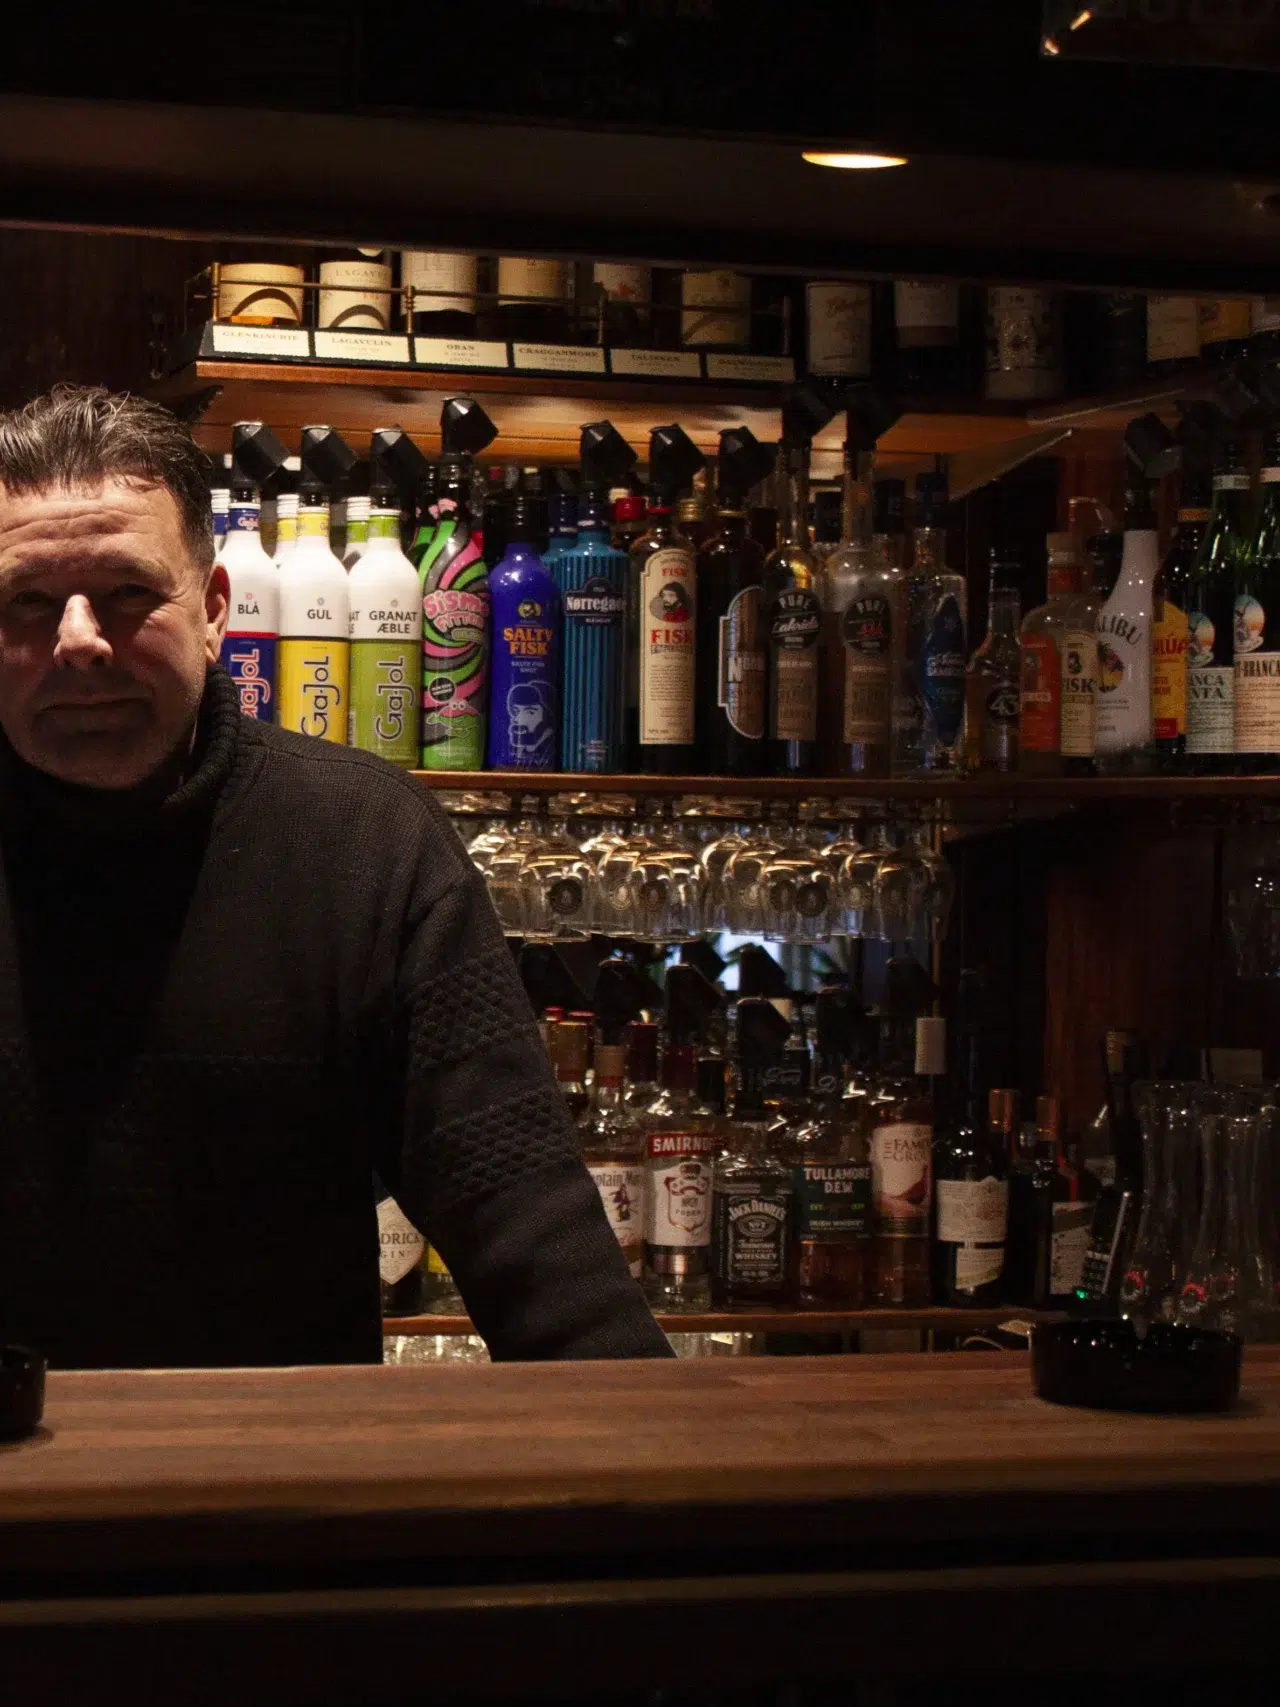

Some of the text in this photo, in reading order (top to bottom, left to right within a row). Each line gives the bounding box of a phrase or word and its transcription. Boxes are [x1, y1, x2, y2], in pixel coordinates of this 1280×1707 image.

[238, 601, 260, 615] BLÅ
[307, 609, 333, 620] GUL
[369, 610, 418, 622] GRANAT
[377, 623, 411, 634] ÆBLE
[503, 627, 552, 643] SALTY
[509, 642, 548, 656] FISK
[804, 1167, 871, 1181] TULLAMORE
